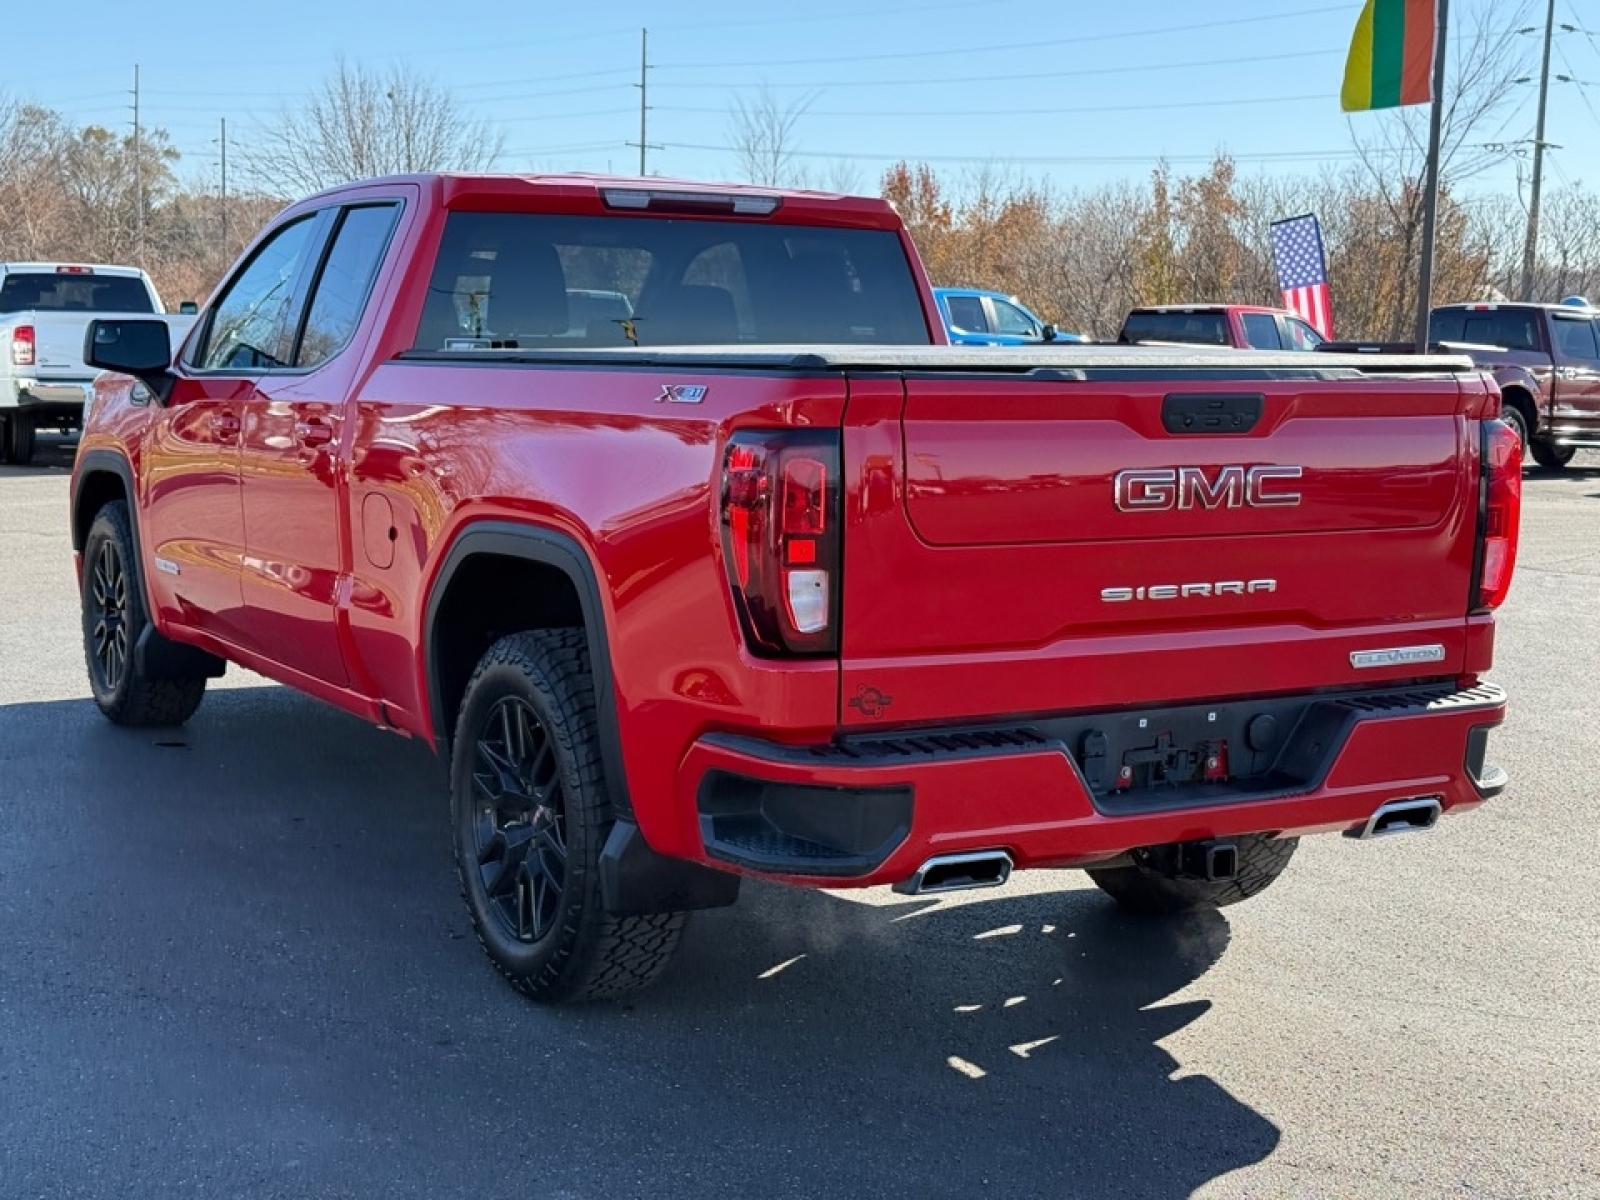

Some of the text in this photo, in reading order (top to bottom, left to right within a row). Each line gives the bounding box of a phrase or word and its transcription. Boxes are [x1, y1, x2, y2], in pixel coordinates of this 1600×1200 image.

[1114, 465, 1302, 512] GMC
[1101, 579, 1278, 602] SIERRA
[1353, 646, 1440, 665] ELEVATION
